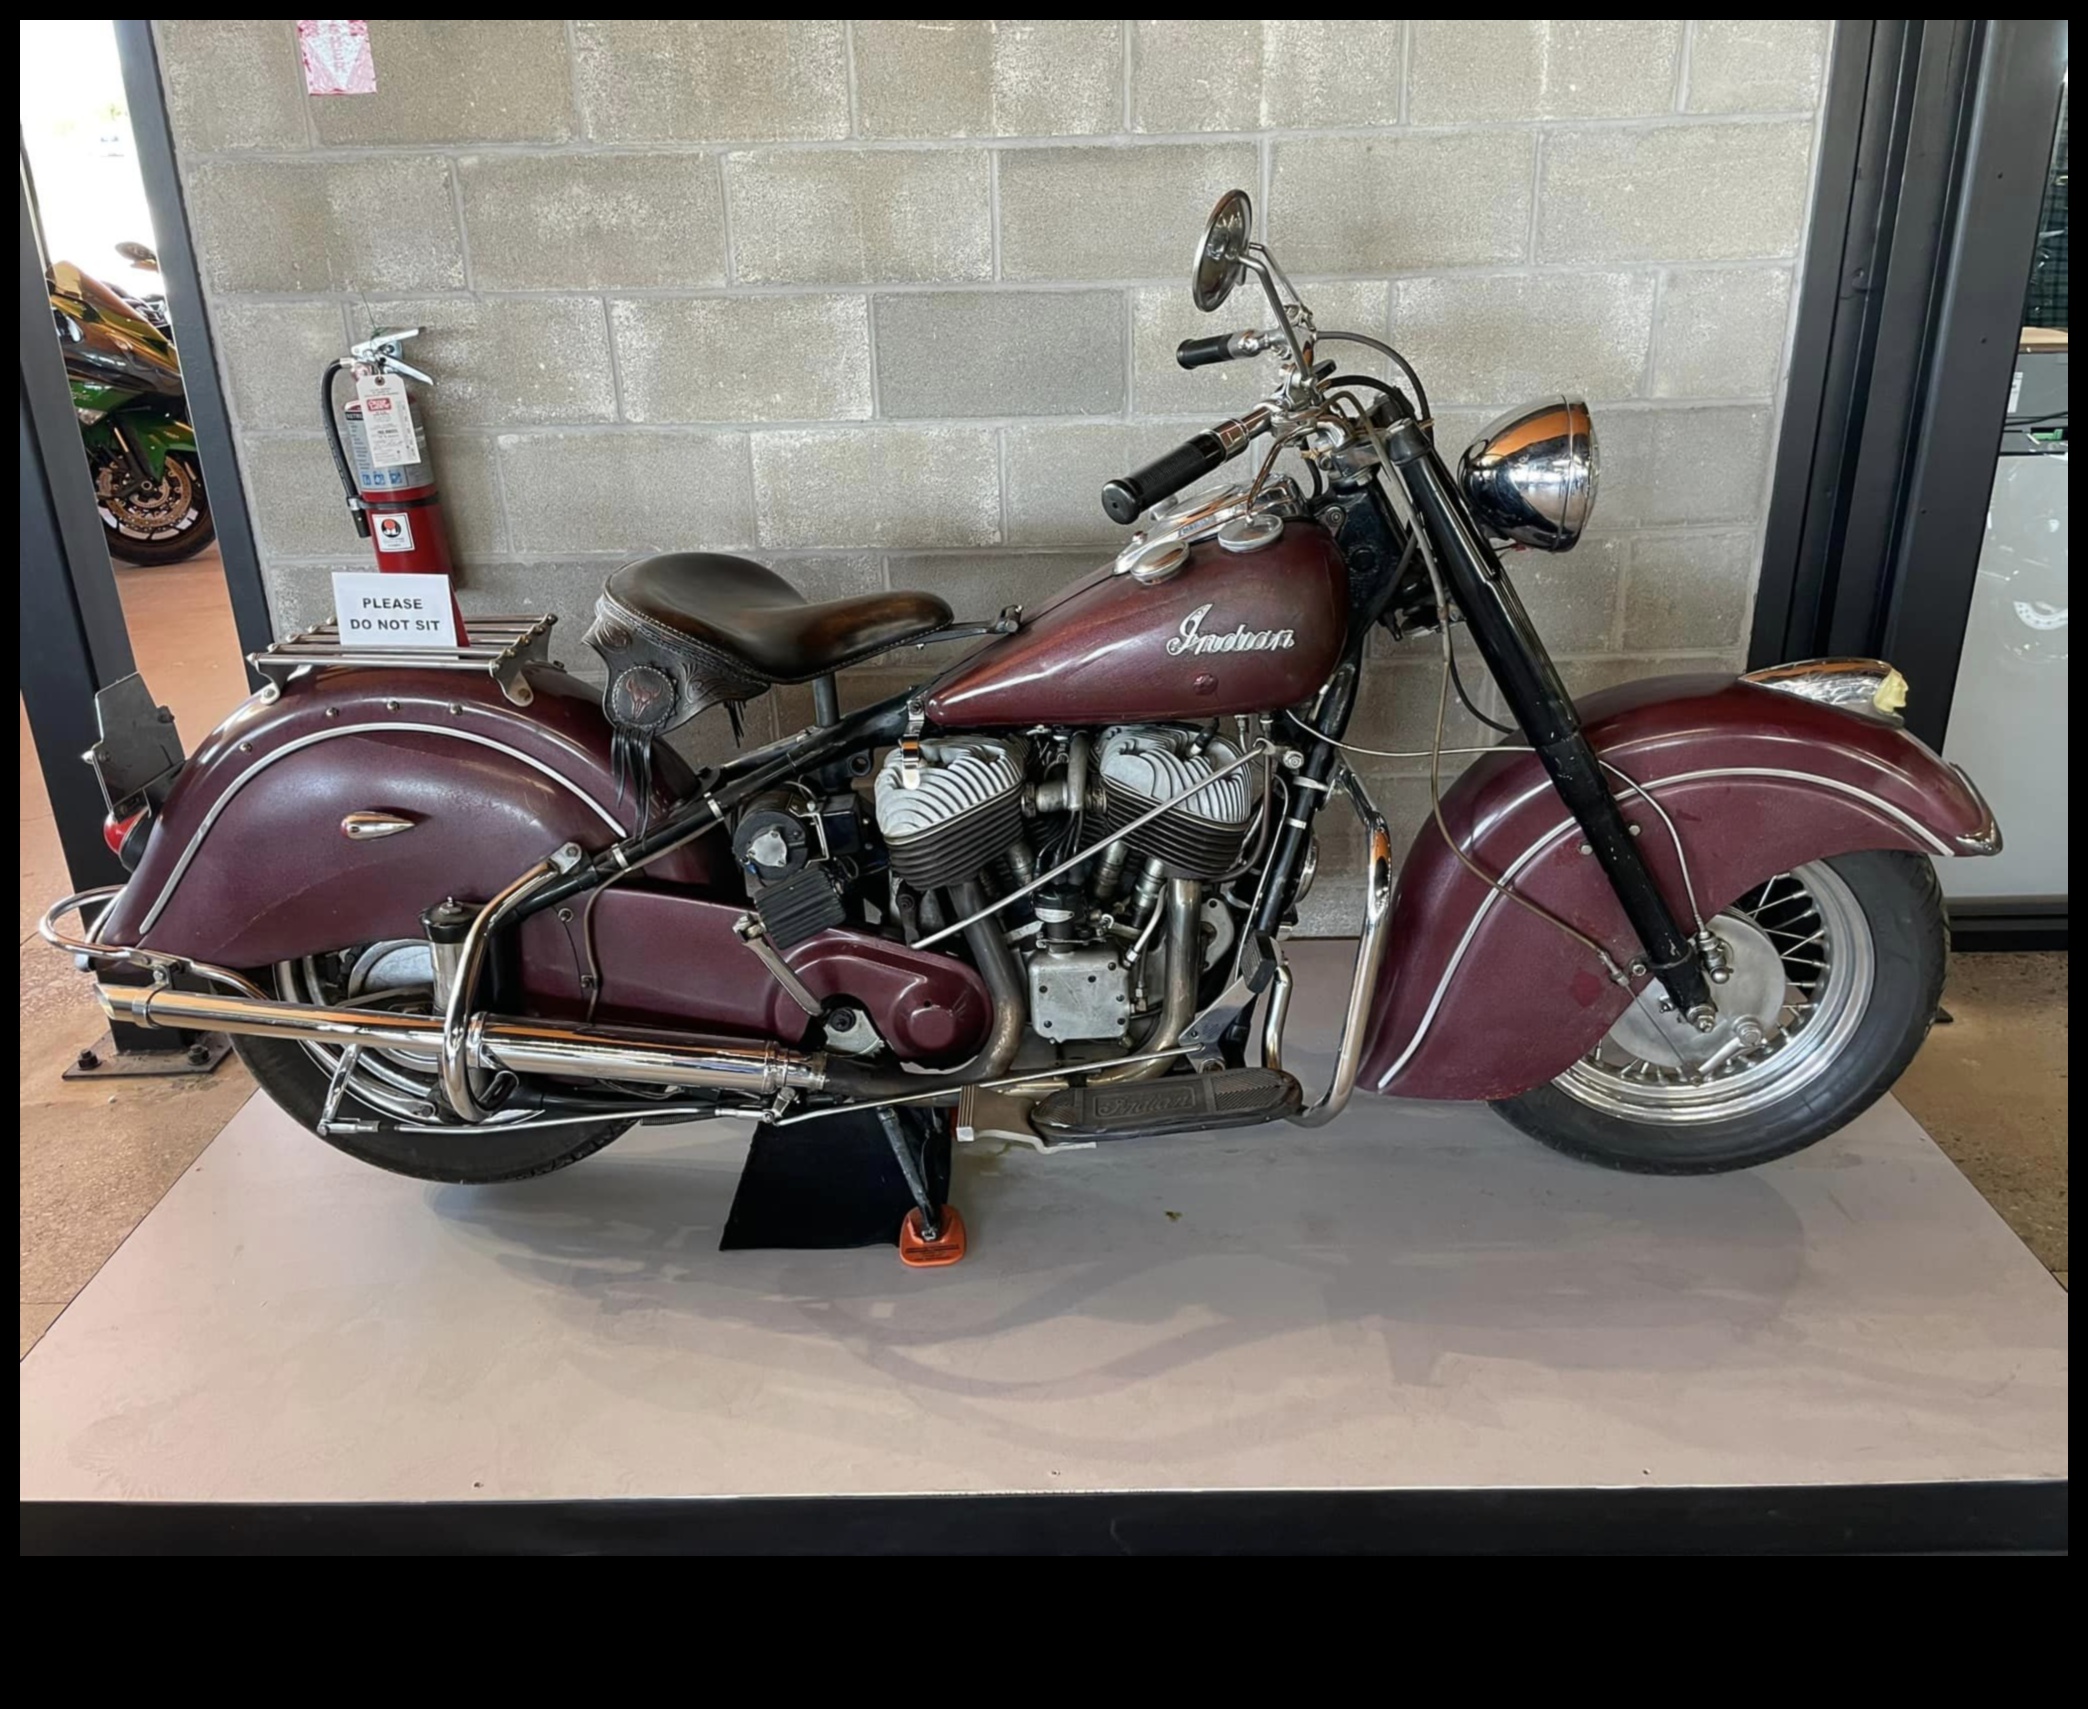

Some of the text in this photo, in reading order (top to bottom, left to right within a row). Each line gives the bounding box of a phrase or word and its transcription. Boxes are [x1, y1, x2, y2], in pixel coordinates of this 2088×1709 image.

[362, 597, 424, 611] PLEASE
[350, 618, 441, 632] DO NOT SIT
[1166, 603, 1295, 656] Indian
